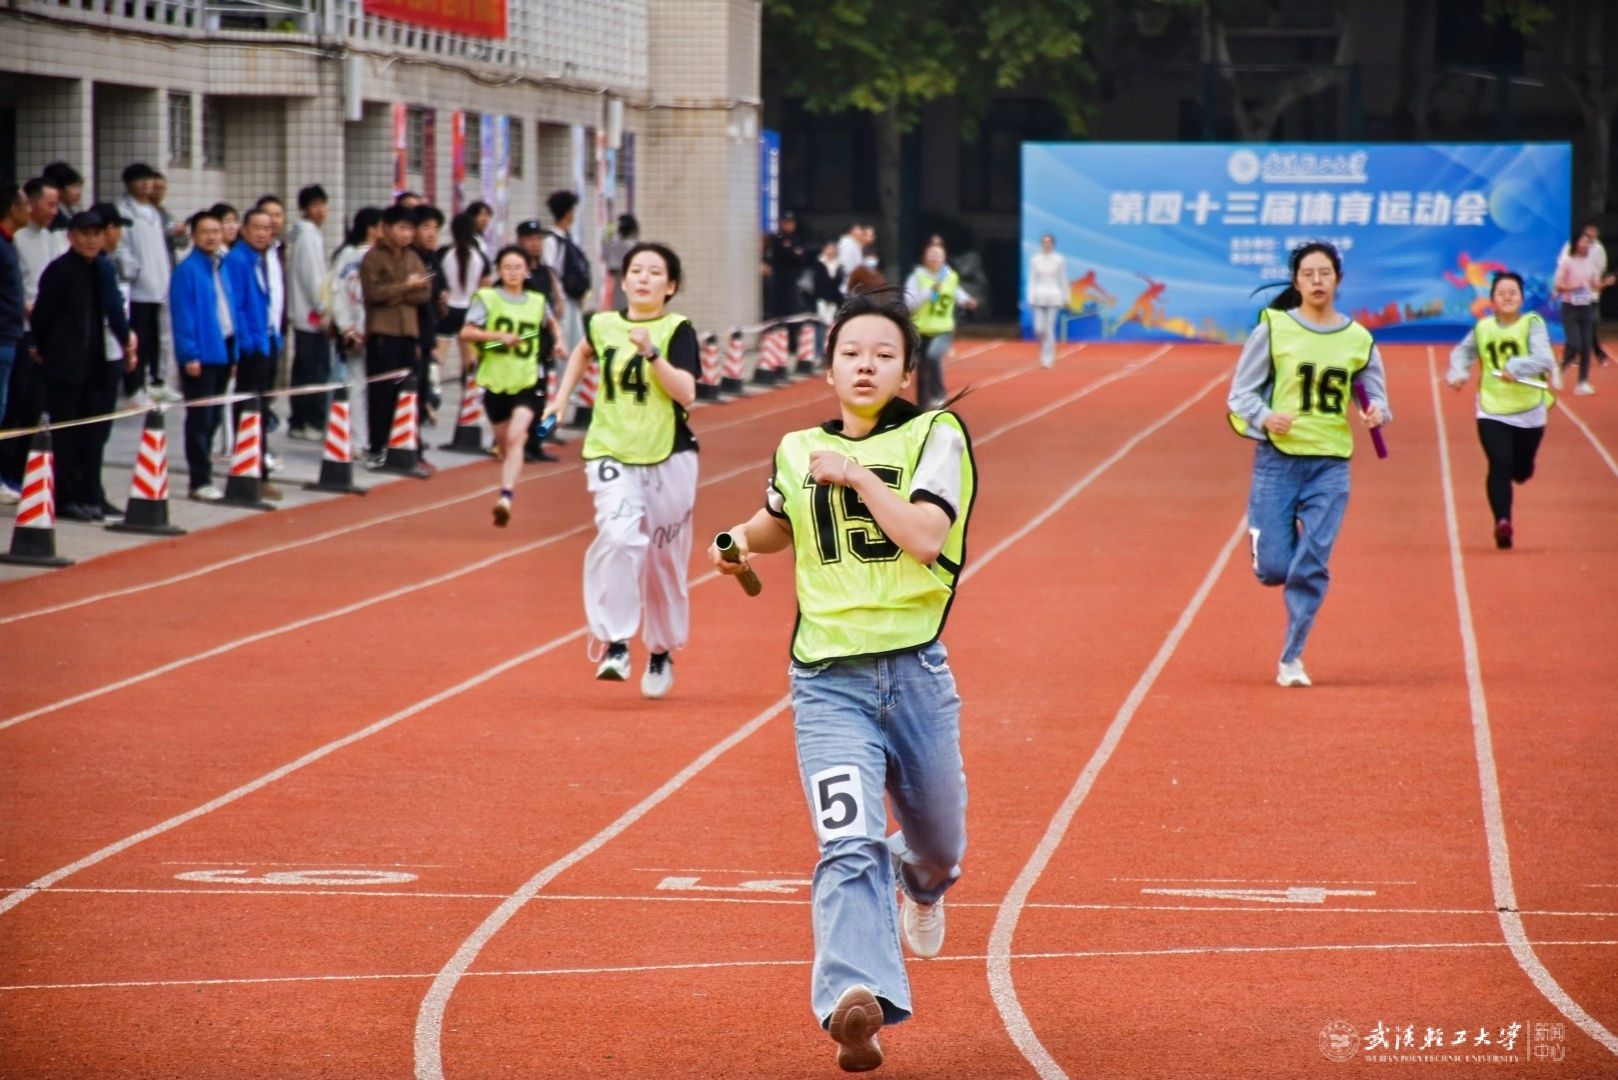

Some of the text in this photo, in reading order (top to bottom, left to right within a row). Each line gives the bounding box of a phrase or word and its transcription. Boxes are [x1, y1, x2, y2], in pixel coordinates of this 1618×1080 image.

[1108, 191, 1489, 226] 第四十三届体育运动会
[483, 316, 538, 358] 25
[601, 346, 650, 405] 14
[1296, 362, 1348, 415] 16
[598, 458, 620, 482] 6
[803, 464, 904, 566] 15
[818, 773, 858, 830] 5
